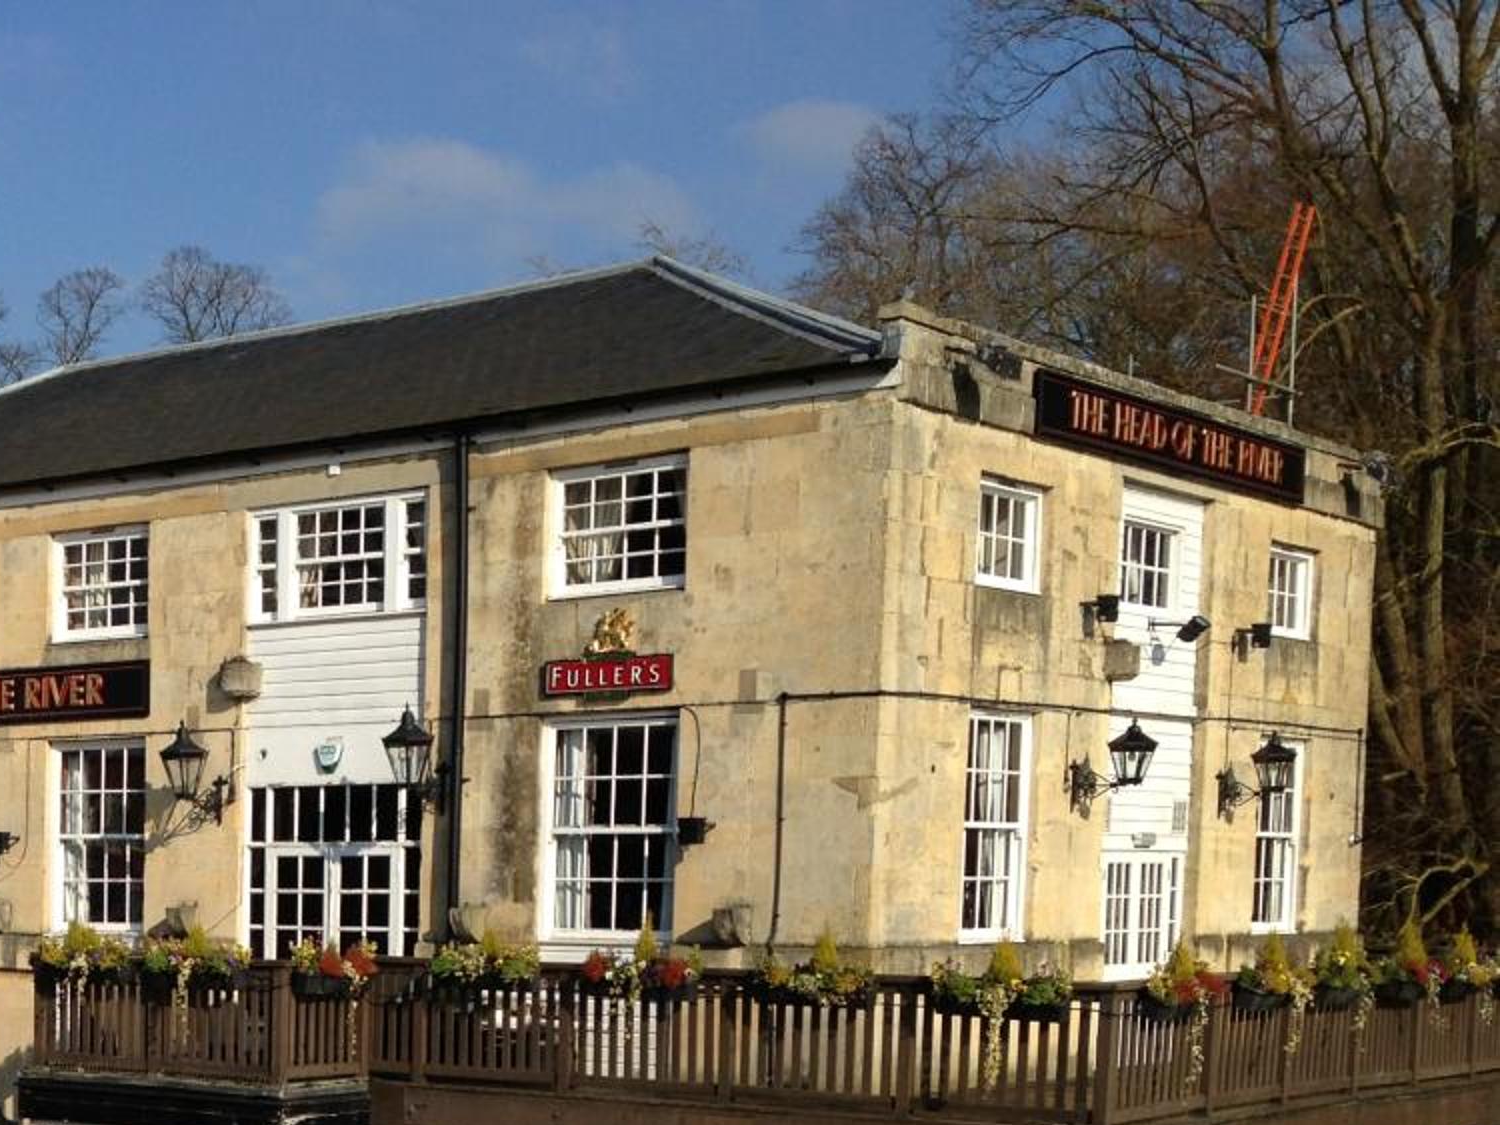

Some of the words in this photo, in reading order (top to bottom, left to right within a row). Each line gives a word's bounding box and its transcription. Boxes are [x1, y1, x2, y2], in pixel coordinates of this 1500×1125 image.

[1071, 390, 1108, 433] THE
[1115, 401, 1168, 449] HEAD
[1171, 420, 1197, 460] OF
[1202, 428, 1233, 470] THE
[24, 672, 104, 710] RIVER
